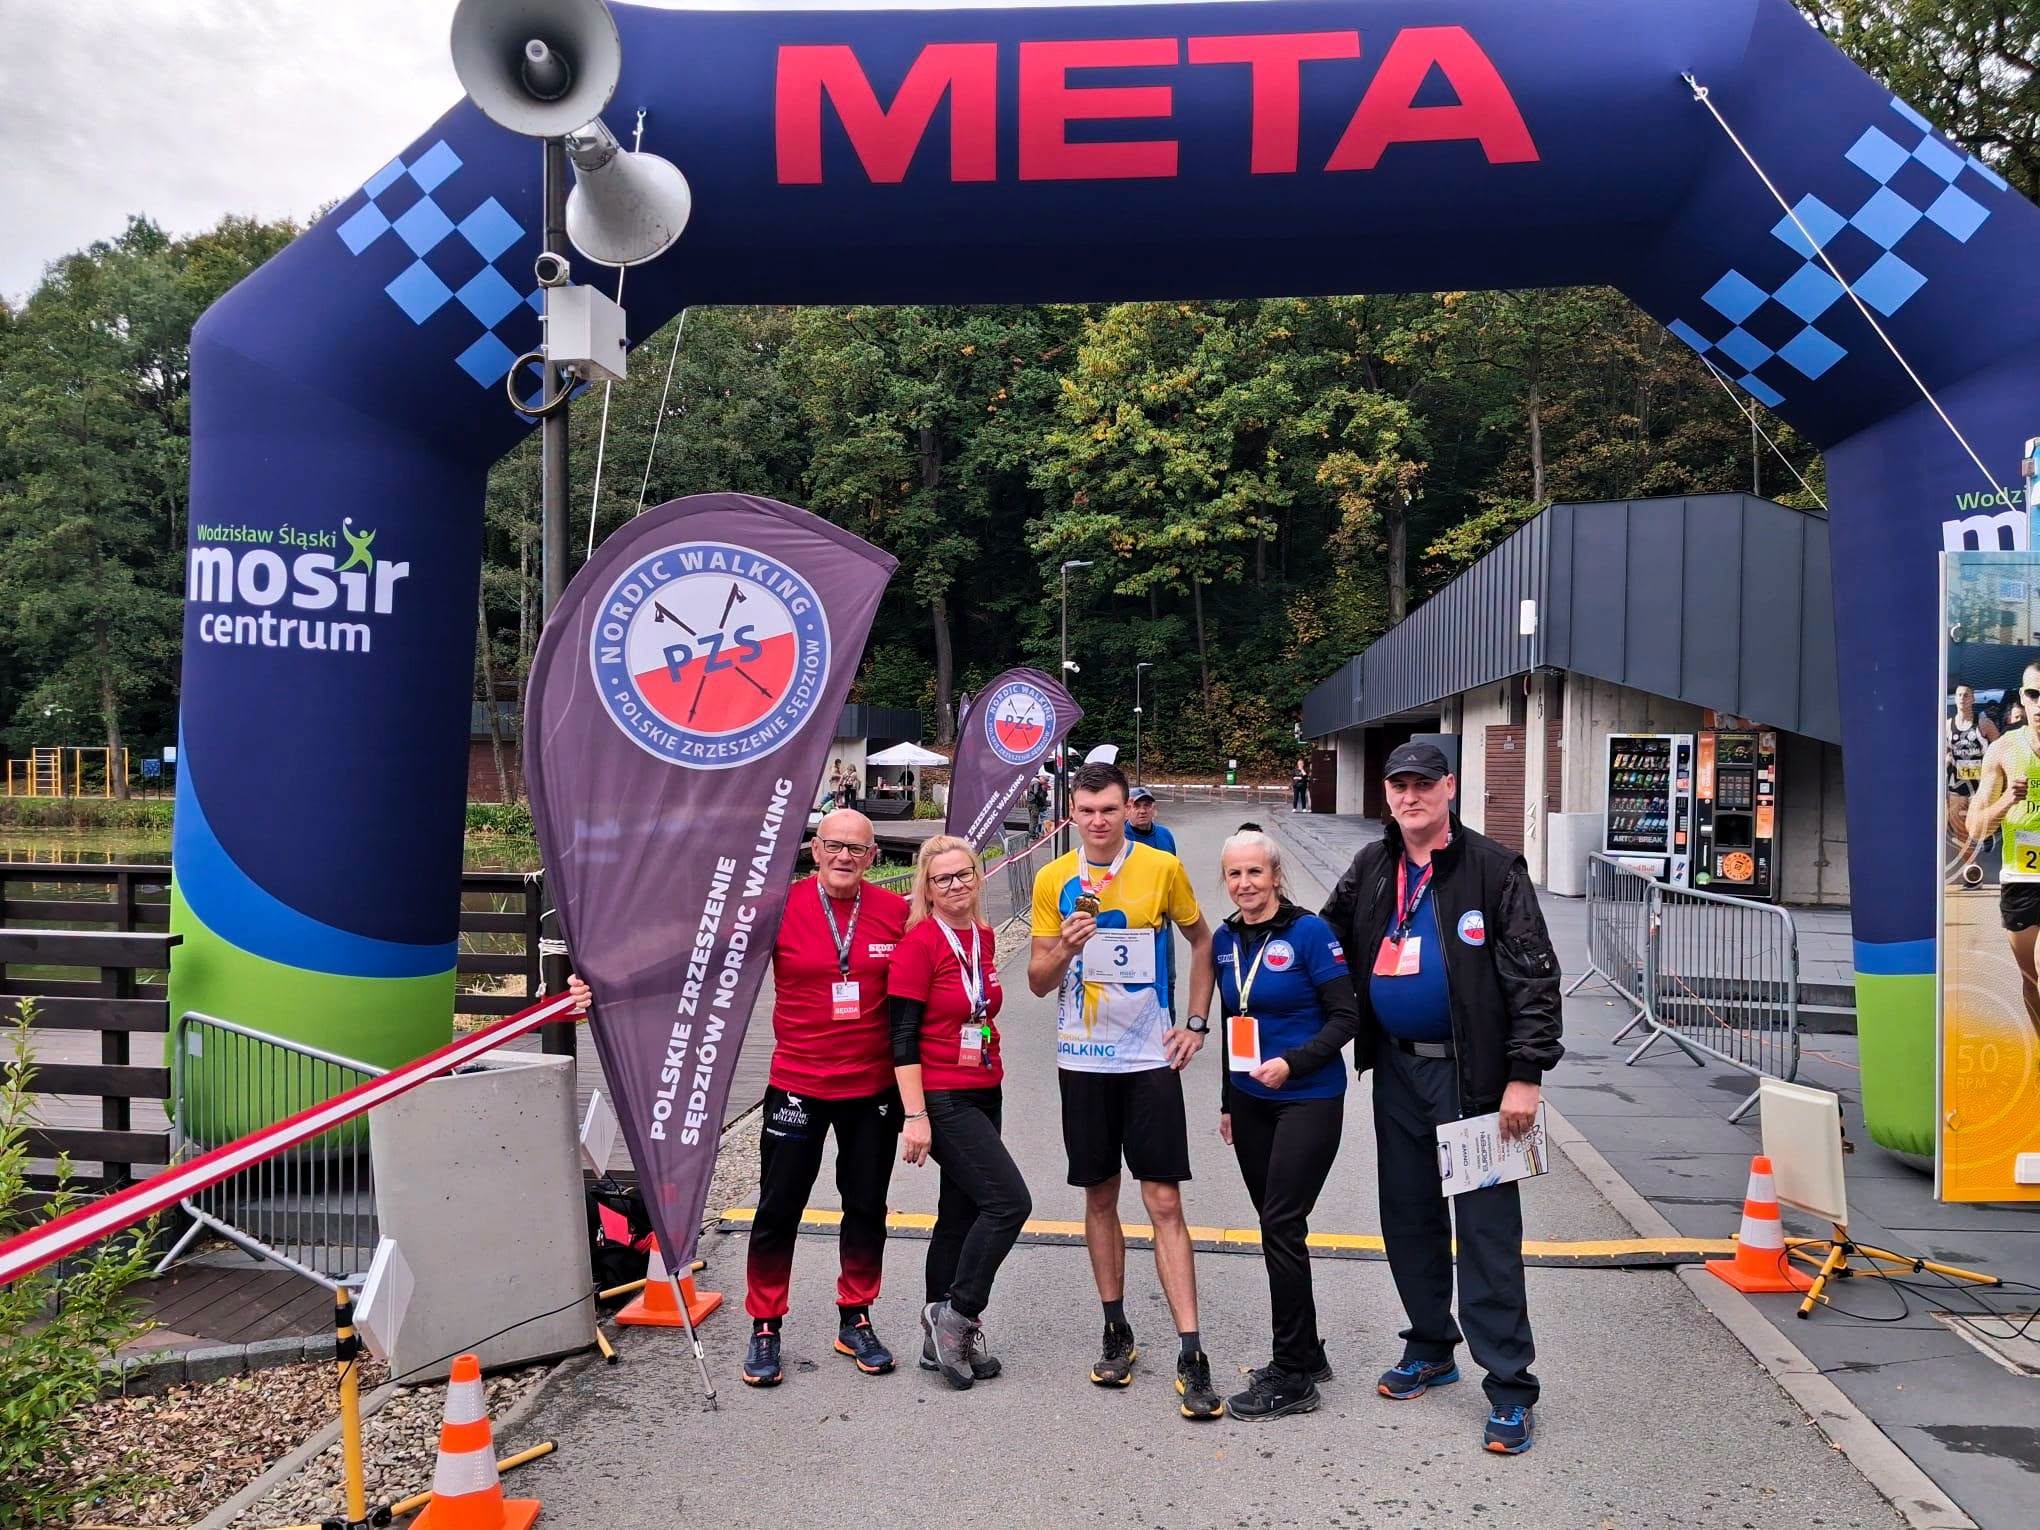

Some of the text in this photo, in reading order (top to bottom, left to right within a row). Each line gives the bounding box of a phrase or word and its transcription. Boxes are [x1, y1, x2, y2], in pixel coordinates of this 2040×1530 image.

[775, 25, 1541, 184] META
[197, 523, 337, 550] Wodzisław Śląski
[190, 546, 409, 614] mosir
[601, 551, 811, 664] NORDIC WALKING
[200, 610, 371, 653] centrum
[663, 625, 762, 682] PZS
[614, 639, 820, 758] POLSKIE ZRZESZENIE SĘDZIÓW
[989, 685, 1053, 721] NORDIC WALKING
[1005, 714, 1034, 730] PZS
[976, 774, 1024, 840] NORDIC WALKING
[681, 777, 793, 1146] SĘDZIÓW NORDIC WALKING
[1113, 945, 1128, 966] 3
[650, 856, 736, 1141] POLSKIE ZRZESZENIE
